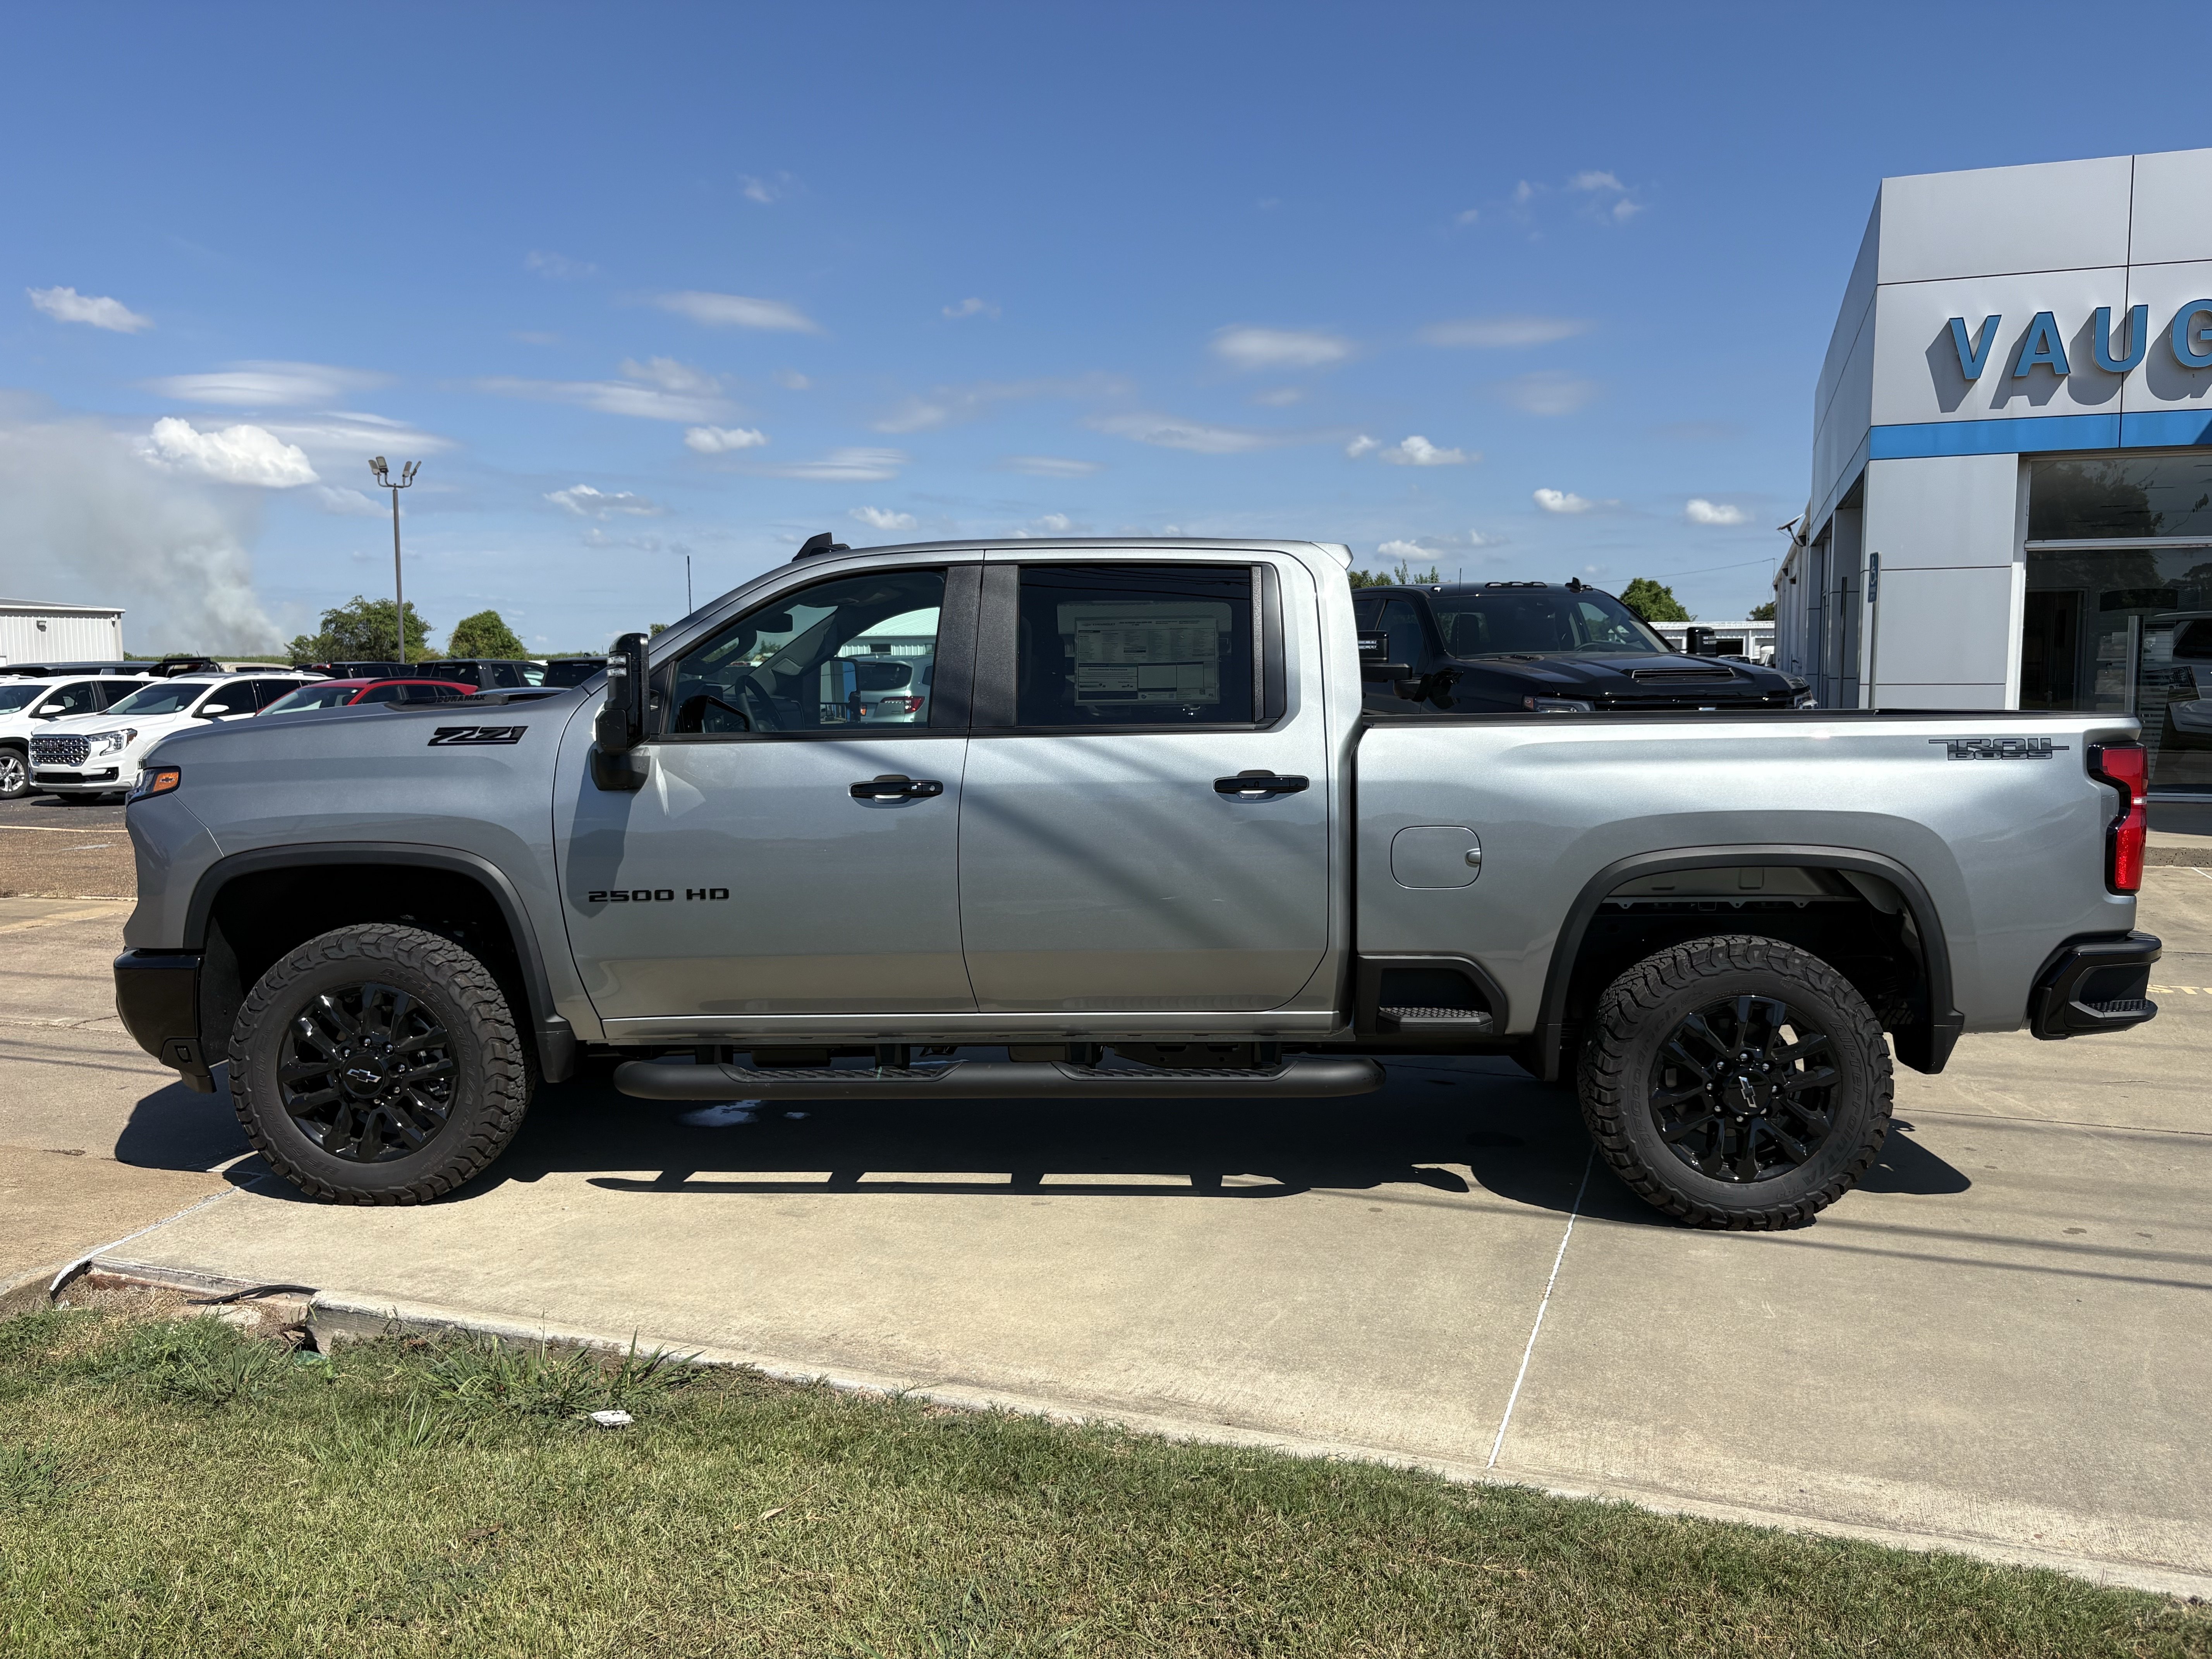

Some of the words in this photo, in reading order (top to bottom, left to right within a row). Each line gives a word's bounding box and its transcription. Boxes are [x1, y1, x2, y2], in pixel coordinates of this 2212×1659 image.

[1949, 298, 2212, 380] VAUG
[436, 694, 488, 703] DURAMAX
[427, 726, 529, 746] Z71
[1929, 738, 2069, 751] TRAIL
[1948, 750, 2053, 761] BOSS
[588, 889, 675, 902] 2500
[686, 888, 730, 901] HD
